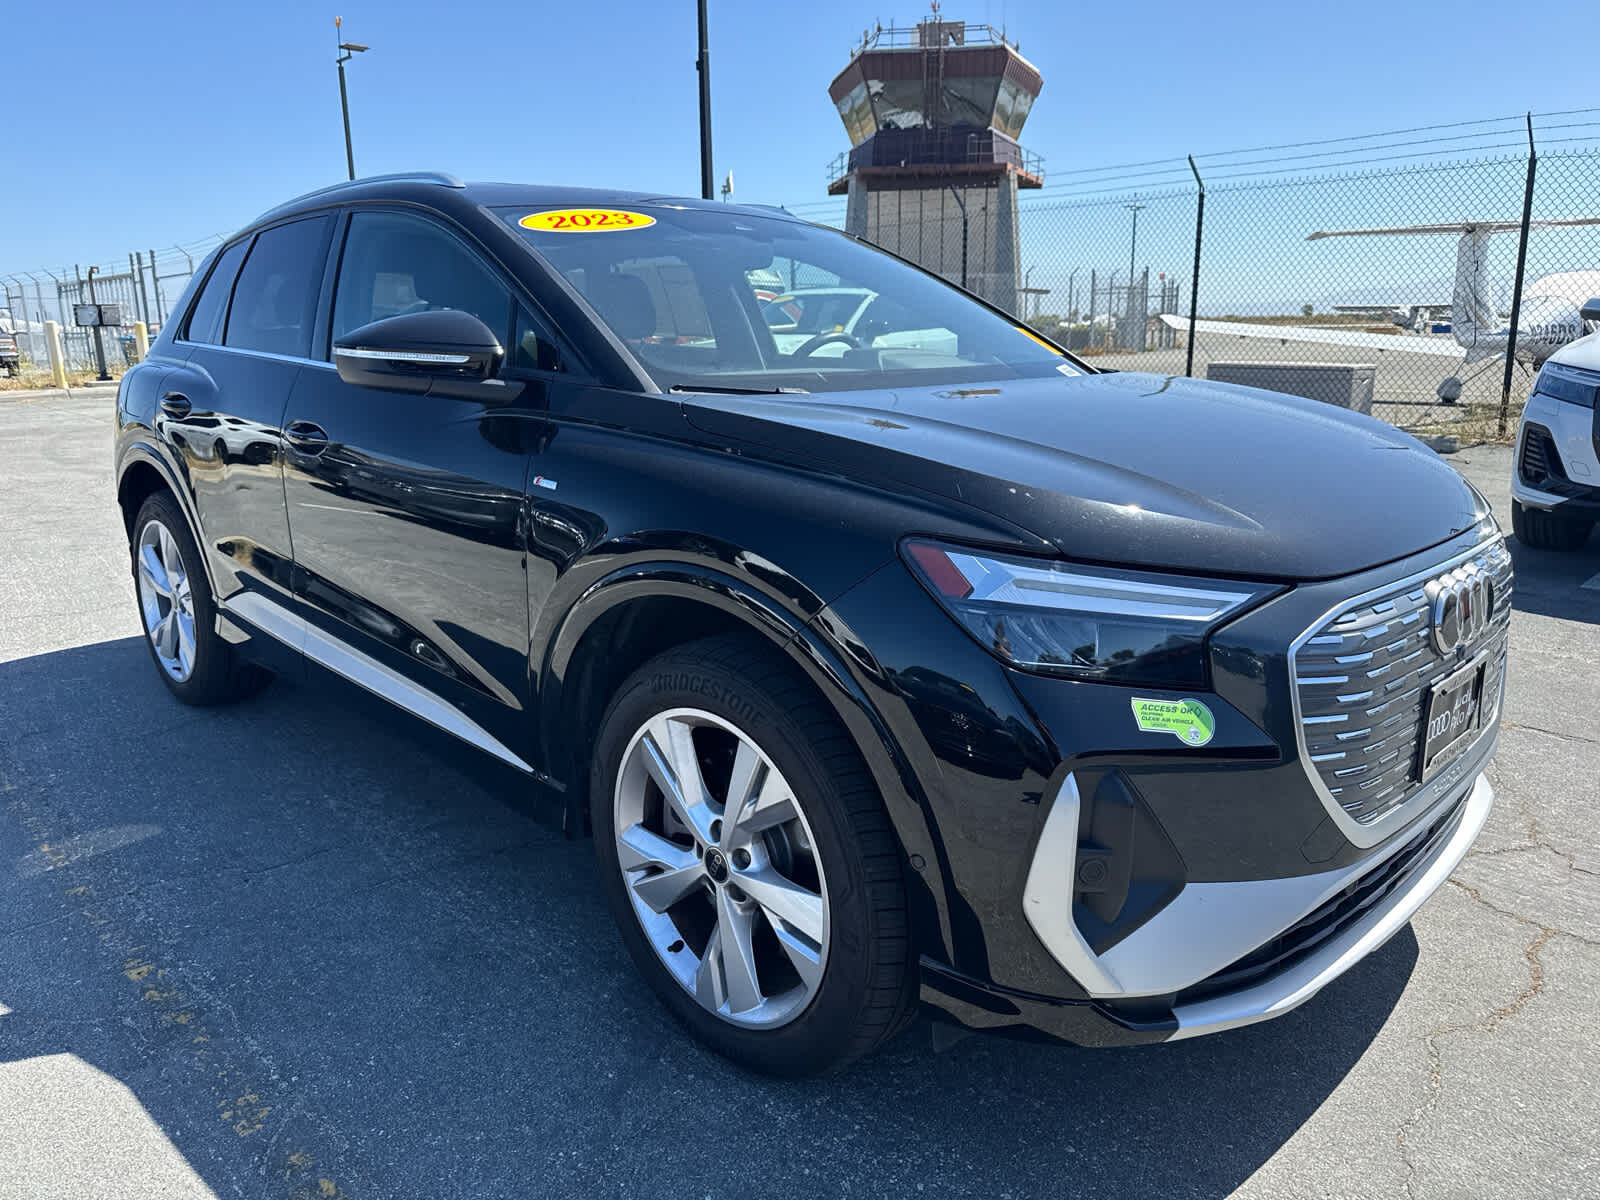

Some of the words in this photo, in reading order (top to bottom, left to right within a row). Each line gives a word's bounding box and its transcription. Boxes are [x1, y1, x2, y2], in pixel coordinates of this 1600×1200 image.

[547, 213, 634, 228] 2023
[648, 672, 766, 724] BRIDGESTONE
[1141, 704, 1177, 713] ACCESS
